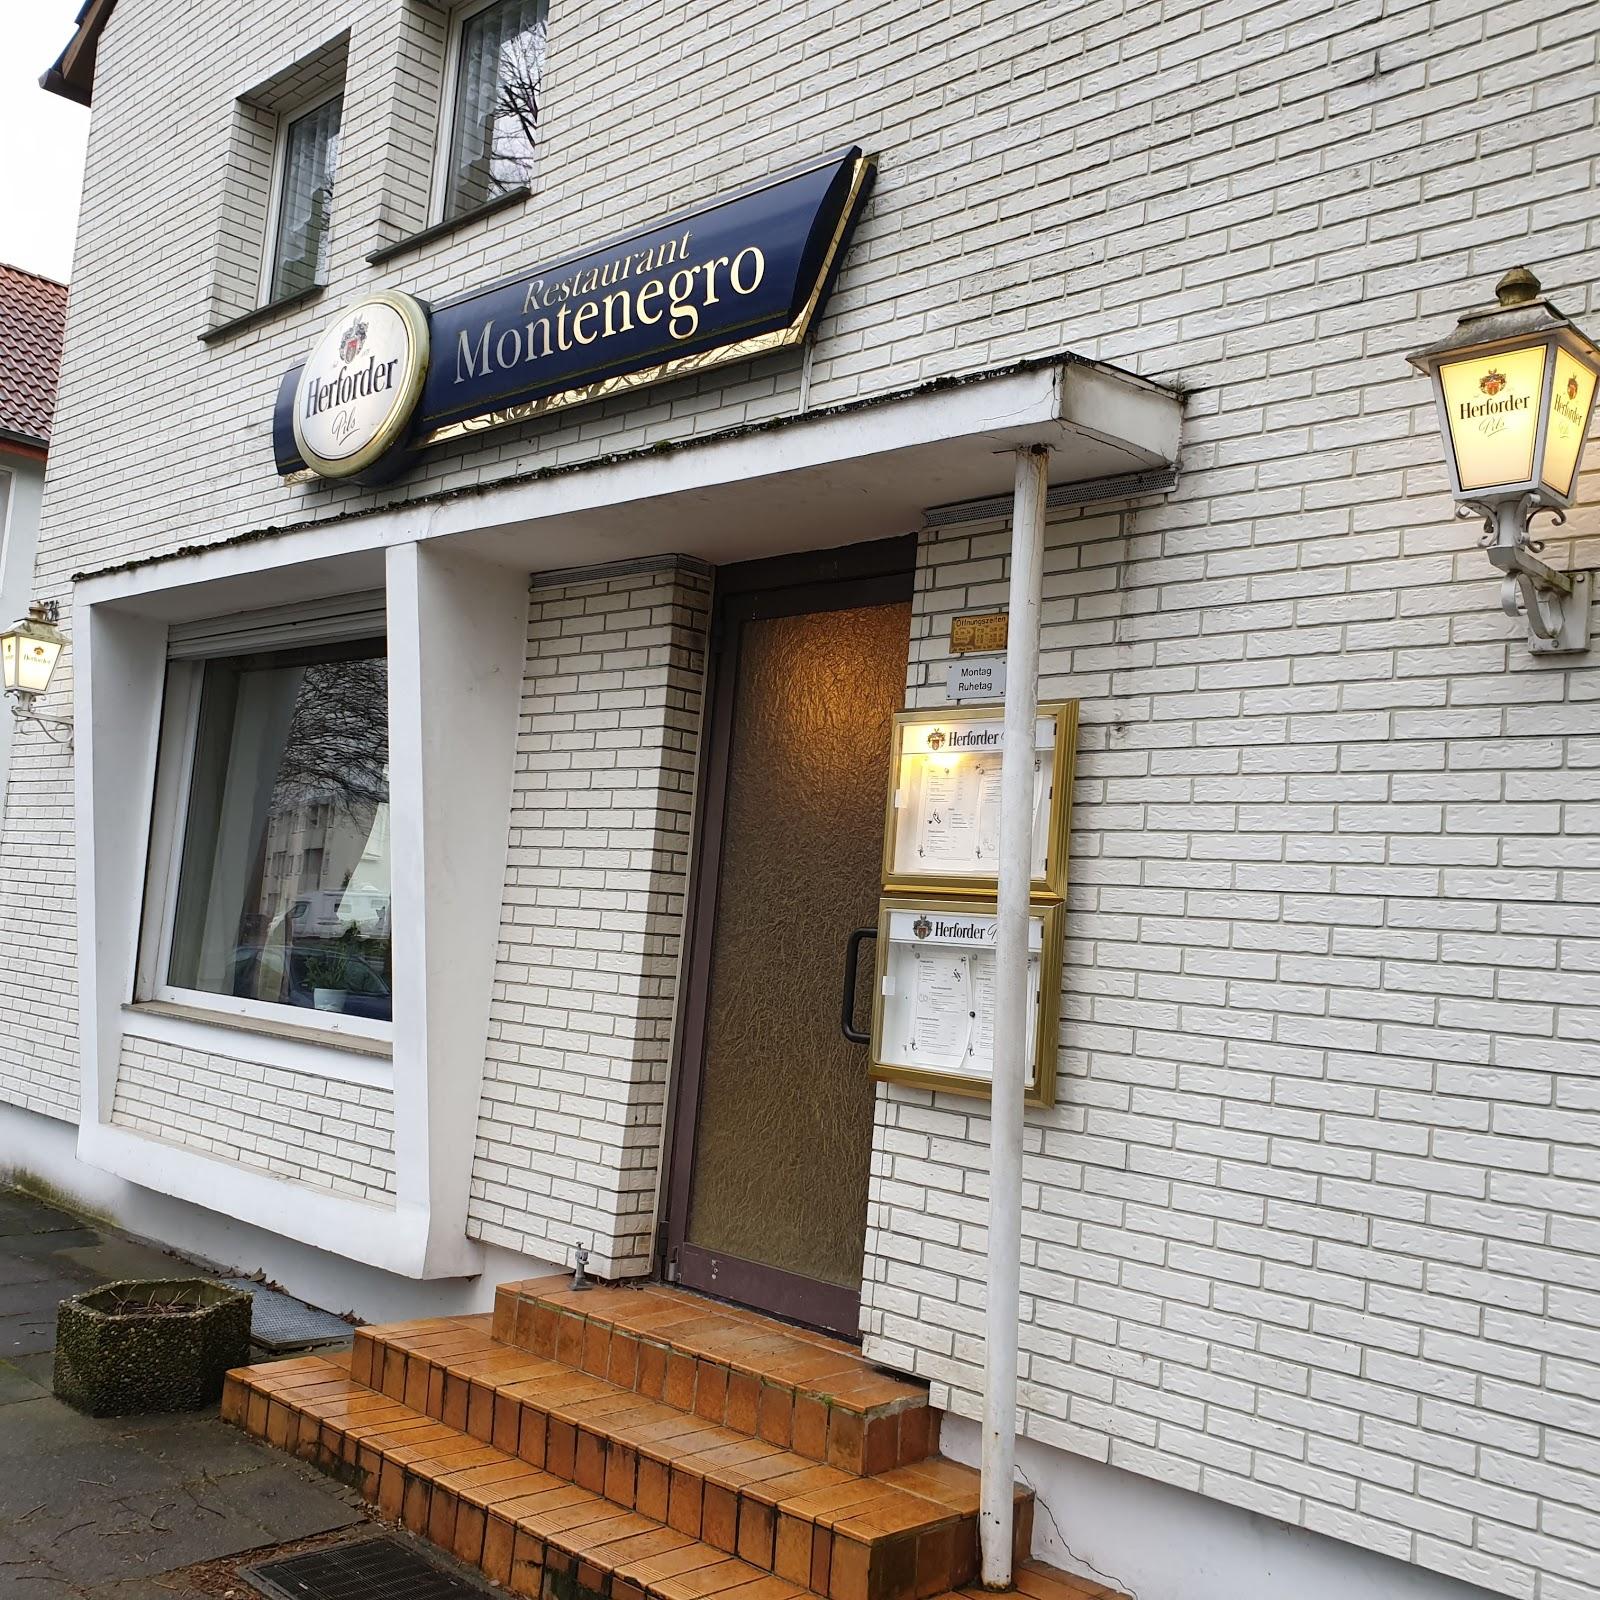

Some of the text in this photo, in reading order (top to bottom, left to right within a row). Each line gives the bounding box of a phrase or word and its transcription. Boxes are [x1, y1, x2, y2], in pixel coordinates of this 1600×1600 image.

[522, 230, 695, 315] Restaurant
[454, 246, 765, 384] Montenegro
[305, 355, 399, 419] Herforder
[1460, 395, 1531, 420] Herforder
[331, 406, 357, 441] Pils
[961, 667, 992, 677] Montag
[958, 681, 993, 691] Ruhetag
[948, 729, 999, 746] Herforder
[934, 921, 986, 939] Herforder
